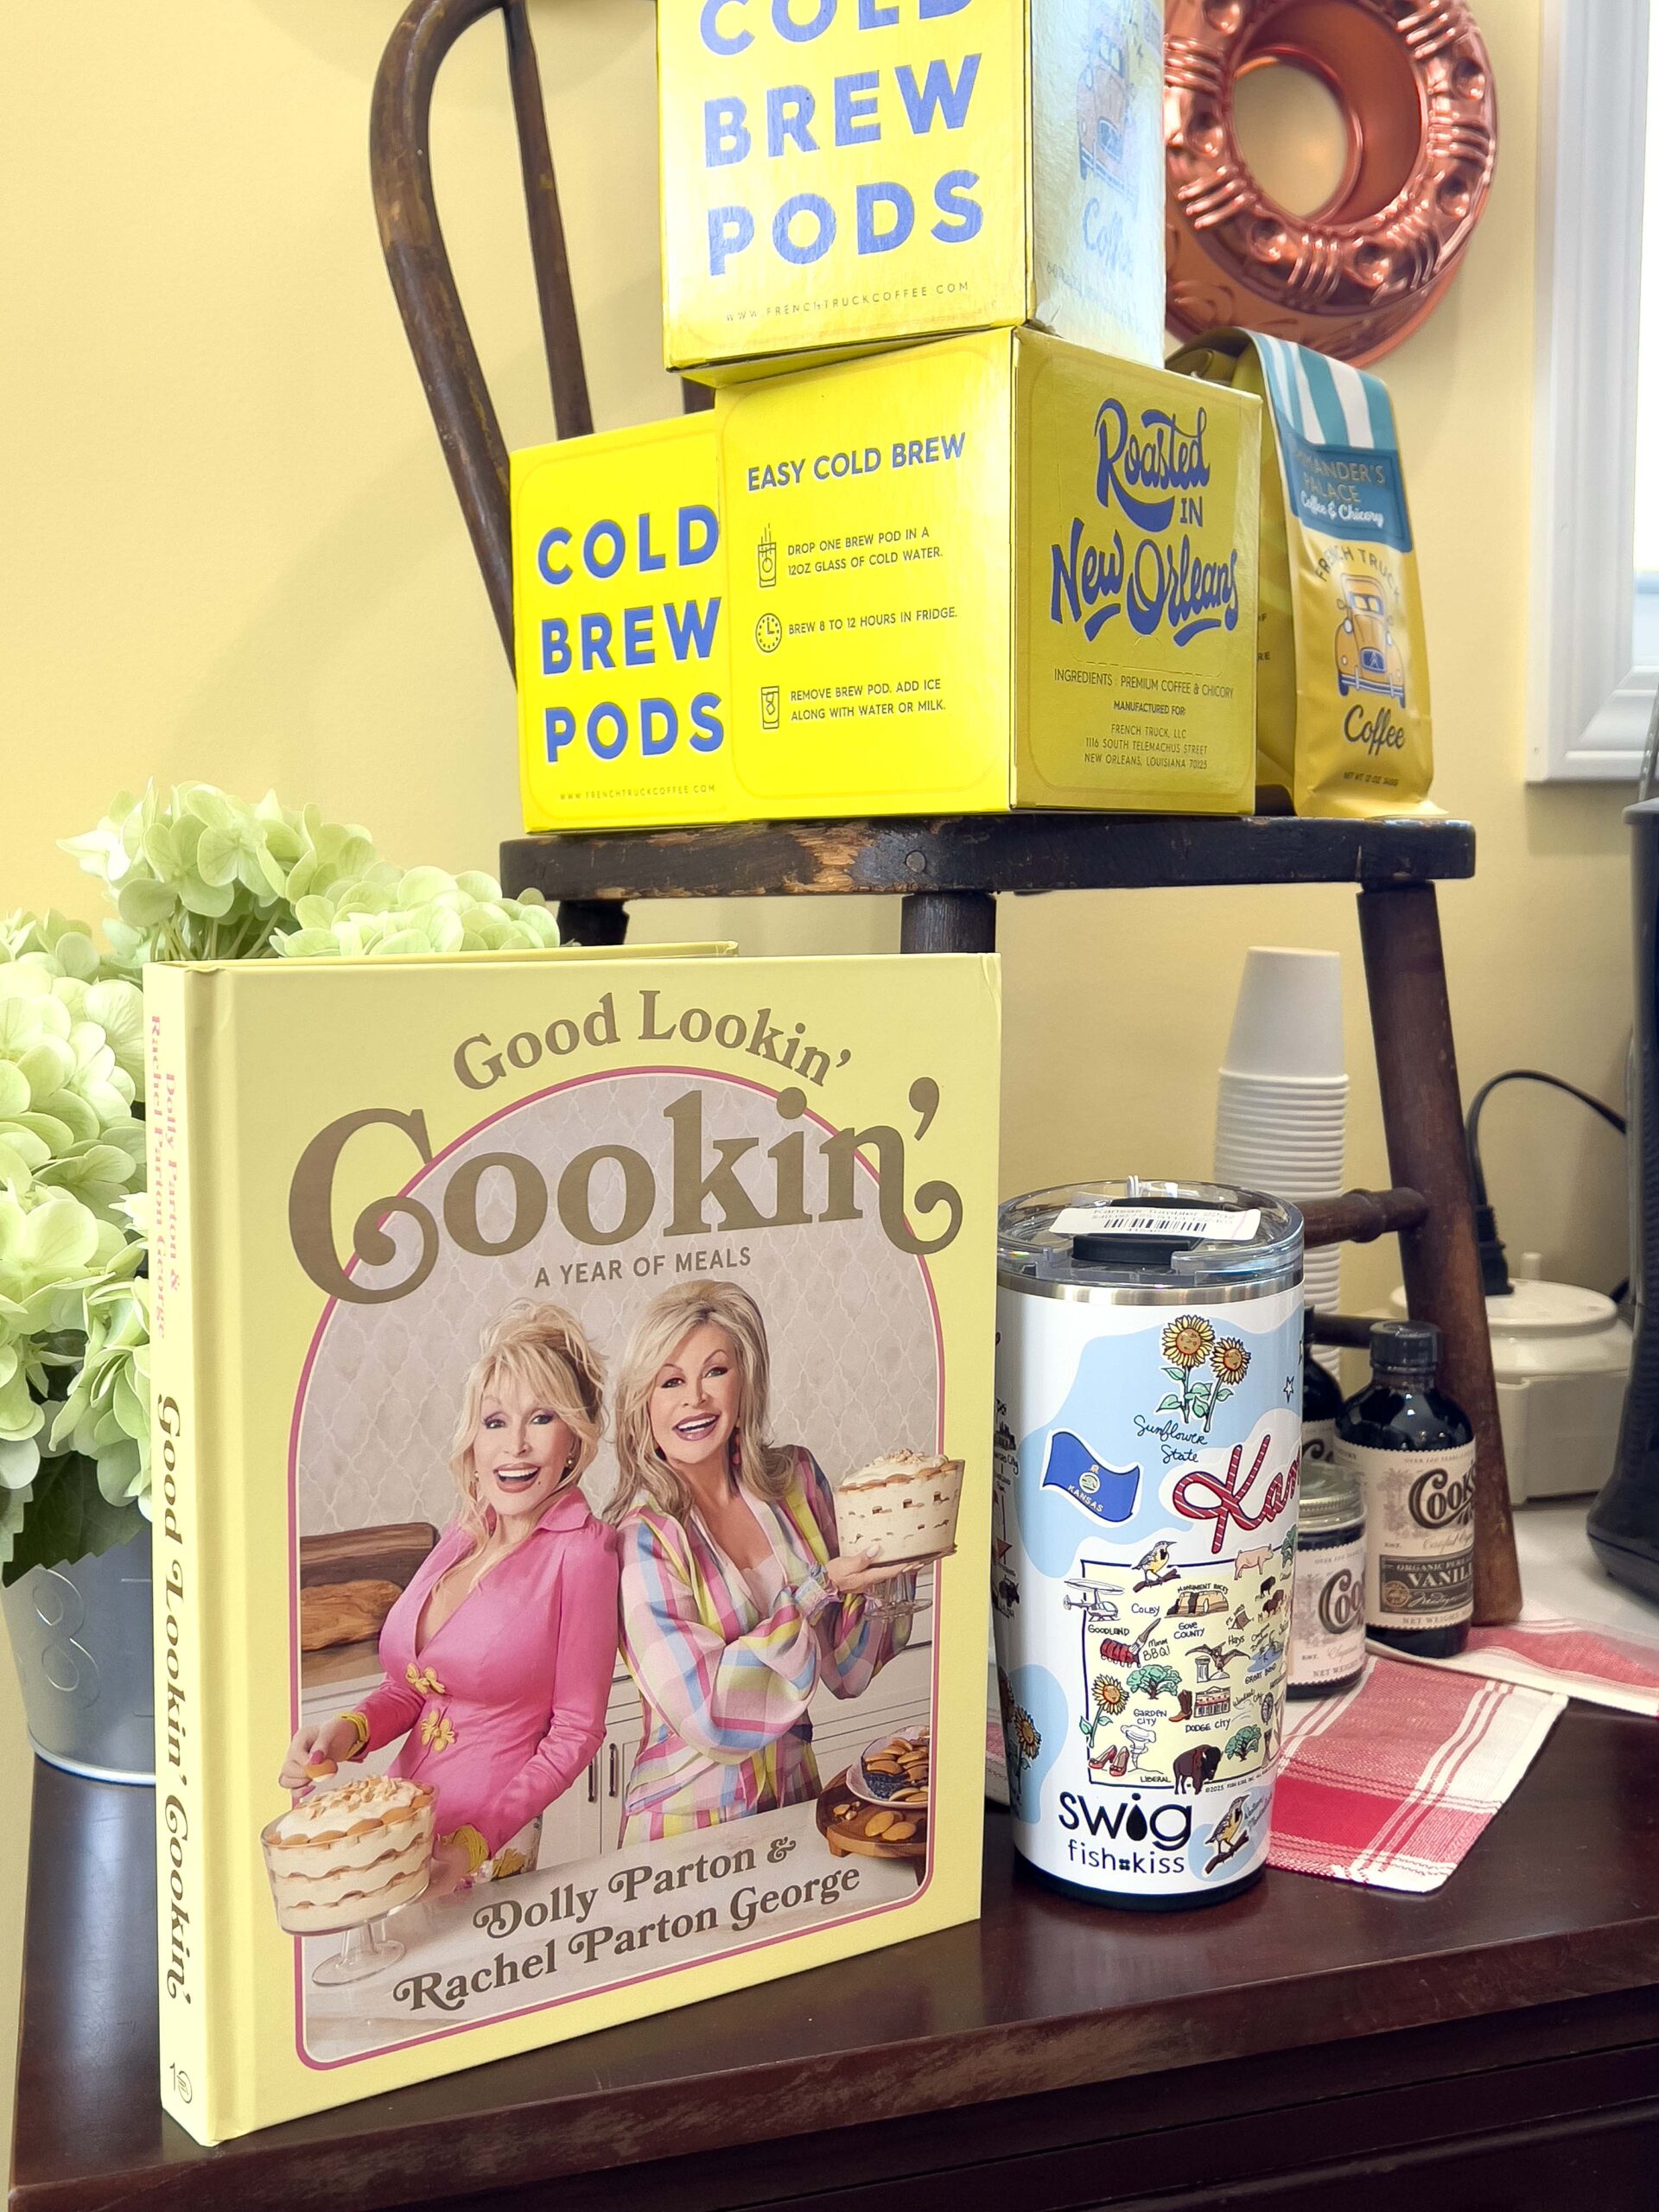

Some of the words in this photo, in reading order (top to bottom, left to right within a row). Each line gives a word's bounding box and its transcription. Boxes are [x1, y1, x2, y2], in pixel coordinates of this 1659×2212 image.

[701, 0, 973, 56] CO
[704, 53, 982, 168] BREW
[707, 169, 984, 276] PODS
[748, 459, 805, 491] EASY
[813, 448, 880, 480] COLD
[892, 432, 966, 468] BREW
[1094, 397, 1210, 533] Roasted
[1179, 496, 1204, 527] IN
[1300, 490, 1327, 516] Coffee
[1327, 501, 1338, 520] &
[1338, 504, 1384, 529] Chicory
[537, 504, 721, 585] COLD
[788, 542, 816, 556] DROP
[820, 538, 842, 551] ONE
[845, 534, 874, 548] BREW
[879, 531, 901, 543] POD
[906, 528, 917, 539] IN
[922, 527, 929, 537] A
[788, 563, 811, 575] 12OZ
[815, 558, 846, 572] GLASS
[851, 556, 864, 568] OF
[869, 552, 898, 566] COLD
[903, 546, 943, 561] WATER.
[1051, 517, 1122, 639] New
[1127, 535, 1239, 647] Orleans
[540, 596, 722, 675] BREW
[788, 621, 816, 635] BREW
[819, 620, 825, 632] 8
[830, 619, 842, 631] TO
[848, 617, 855, 628] 12
[861, 613, 896, 627] HOURS
[901, 611, 912, 622] IN
[916, 607, 957, 621] FRIDGE.
[791, 688, 831, 702] REMOVE
[836, 685, 862, 697] BREW
[868, 683, 892, 695] POD.
[896, 681, 919, 692] ADD
[924, 678, 941, 690] ICE
[1121, 676, 1158, 691] PREMIUM
[1161, 680, 1192, 694] COFFEE
[1193, 683, 1199, 695] &
[1202, 684, 1234, 699] CHICORY
[791, 709, 825, 721] ALONG
[830, 707, 855, 718] WITH
[859, 703, 893, 716] WATER
[899, 702, 913, 713] OR
[918, 699, 946, 712] MILK.
[1113, 700, 1169, 715] MANUFACTURED
[544, 691, 725, 763] PODS
[1111, 723, 1141, 735] FRENCH
[1173, 729, 1186, 739] LLC
[1344, 704, 1405, 756] Coffee
[1084, 753, 1102, 763] NEW
[1147, 756, 1186, 768] LOUISIANA
[1085, 737, 1099, 748] 1116
[1103, 739, 1129, 750] SOUTH
[1133, 741, 1180, 753] TELEMACHUS
[1184, 744, 1208, 755] STREET
[453, 992, 620, 1091] Good
[534, 1268, 550, 1288] A
[560, 1257, 623, 1285] YEAR
[633, 1254, 665, 1277] OF
[675, 1246, 752, 1270] MEALS
[1134, 1414, 1208, 1446] Sunflower
[1161, 1444, 1199, 1464] State
[157, 1395, 184, 1546] Good
[1067, 1483, 1105, 1514] KANSAS
[1172, 1434, 1300, 1554] Kan
[1396, 1562, 1445, 1572] ORGANIC
[1177, 1583, 1211, 1593] MONUMENT
[1173, 1628, 1205, 1640] COUNTY
[1143, 1644, 1171, 1662] BBQ!
[1185, 1720, 1211, 1733] DODGE
[1058, 1791, 1192, 1851] swig
[473, 1883, 597, 1939] Dolly
[608, 1850, 755, 1903] Parton
[767, 1836, 796, 1863] &
[392, 1942, 556, 2012] Rachel
[568, 1903, 718, 1963] Parton
[730, 1868, 860, 1931] George
